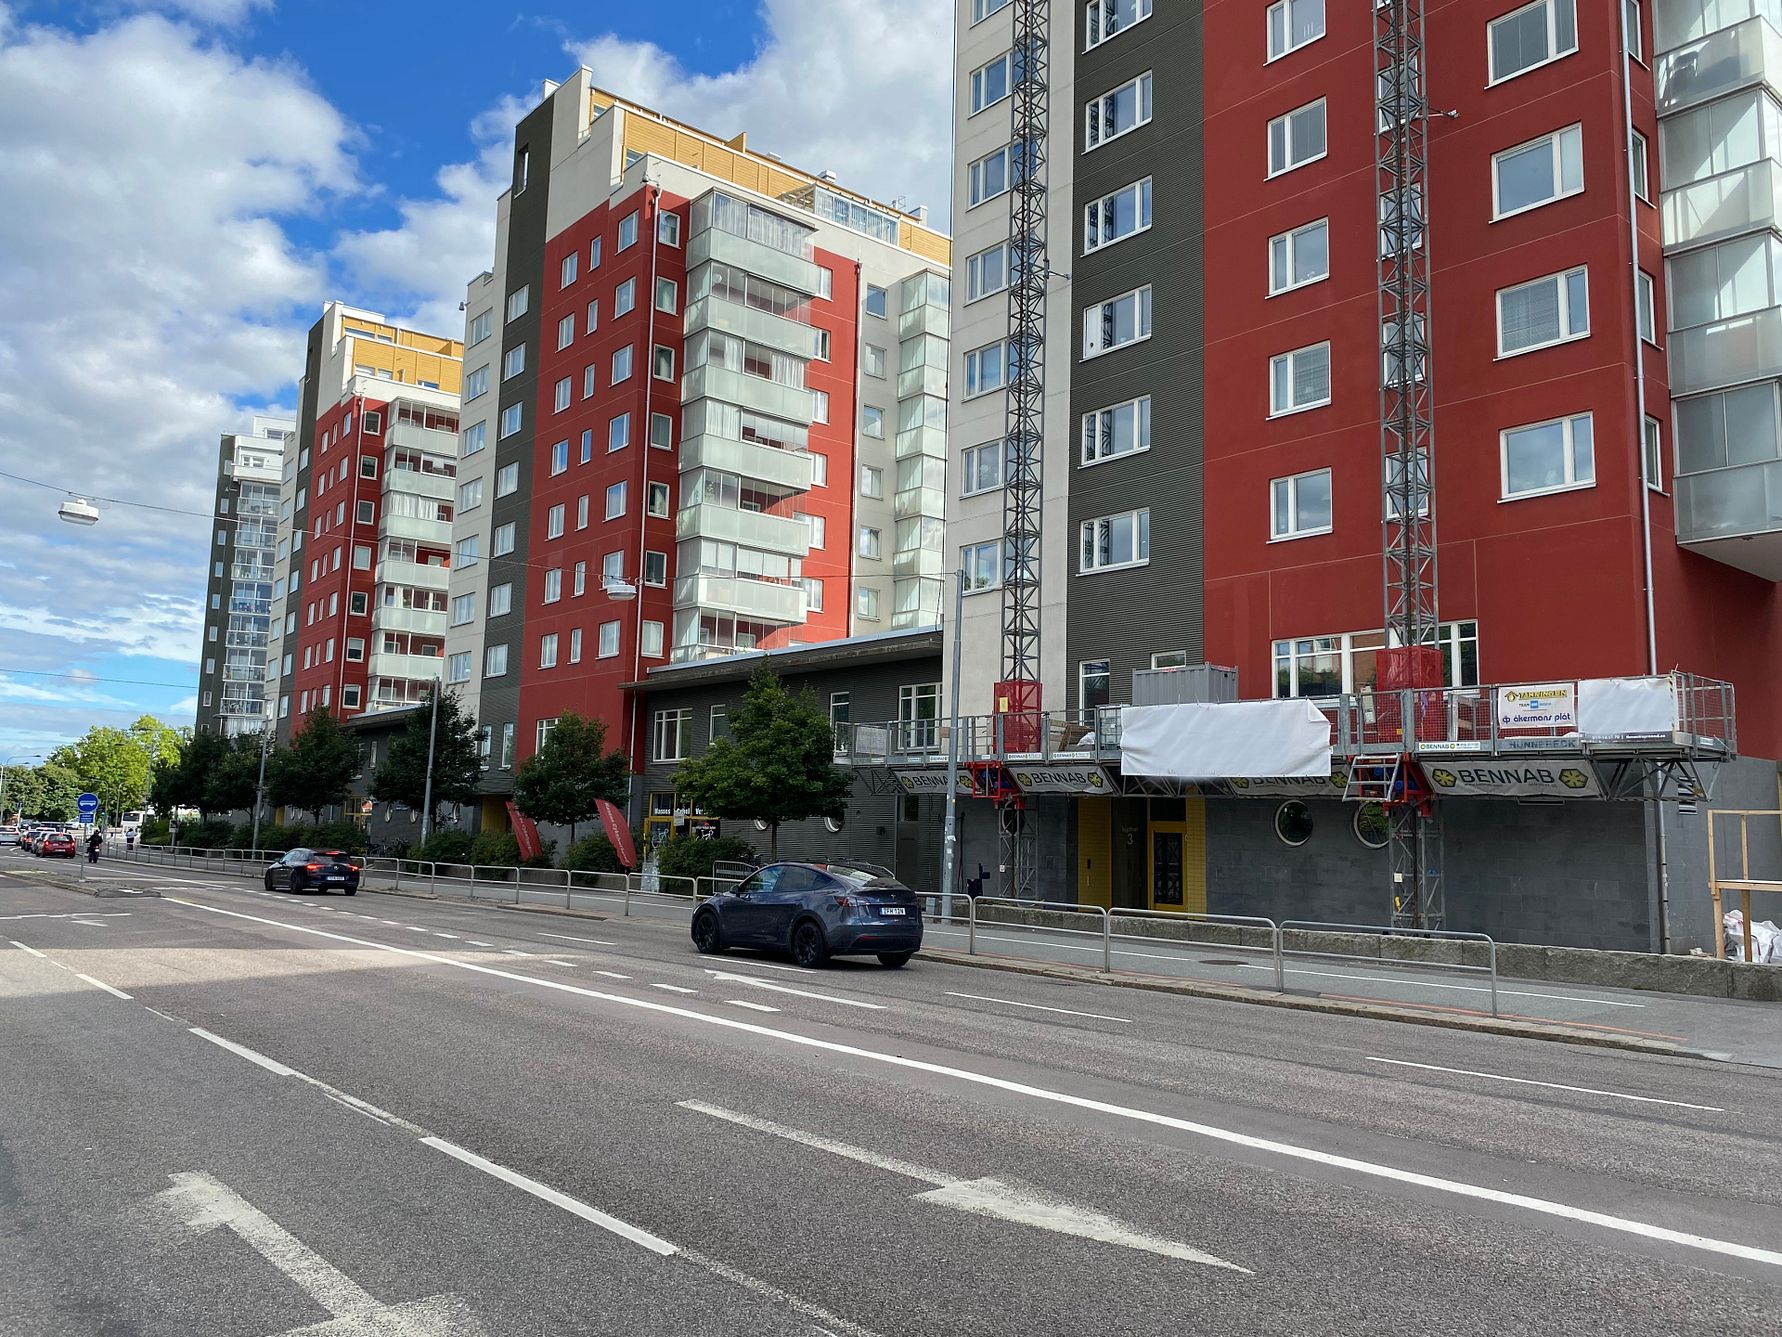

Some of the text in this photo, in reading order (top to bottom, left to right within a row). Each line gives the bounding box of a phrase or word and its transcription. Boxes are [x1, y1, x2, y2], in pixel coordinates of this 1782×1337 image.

[912, 775, 959, 786] BENNA
[1031, 772, 1087, 784] BENNAB
[1458, 769, 1554, 784] BENNAB
[1126, 833, 1134, 845] 3
